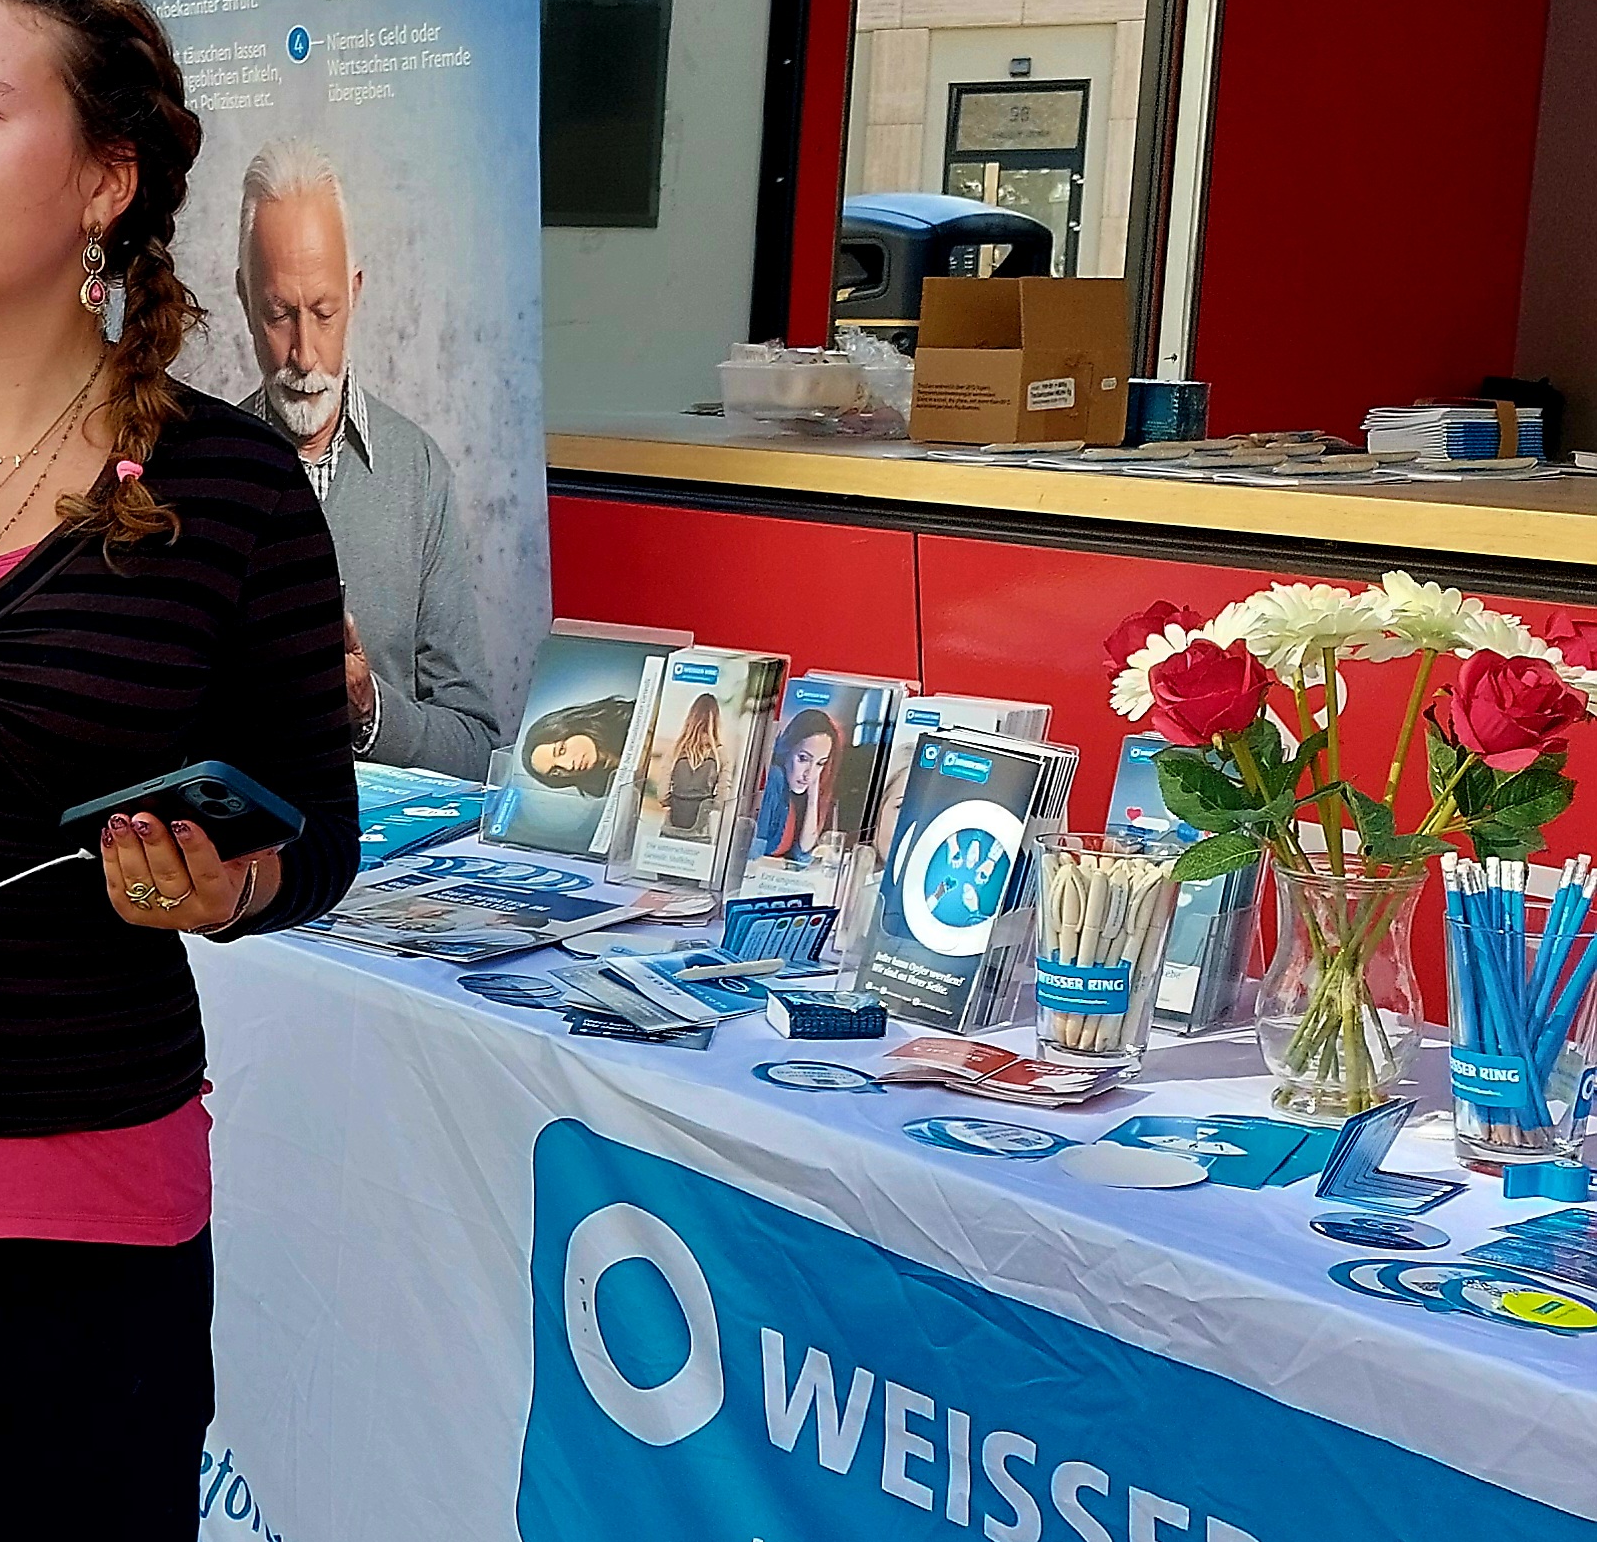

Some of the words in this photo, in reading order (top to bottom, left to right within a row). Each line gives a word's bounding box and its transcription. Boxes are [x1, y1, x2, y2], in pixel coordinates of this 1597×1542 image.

[294, 33, 304, 53] 4
[326, 28, 375, 51] Niemals
[378, 24, 407, 46] Geld
[411, 22, 442, 43] oder
[183, 44, 231, 64] täuschen
[234, 41, 266, 59] lassen
[327, 54, 398, 77] Wertsachen
[401, 55, 417, 72] an
[421, 46, 472, 69] Fremde
[242, 63, 283, 86] Enkeln,
[201, 92, 252, 111] Polizisten
[254, 92, 274, 108] etc.
[328, 80, 395, 106] übergeben.
[1087, 979, 1125, 991] RING
[1479, 1066, 1520, 1083] RING
